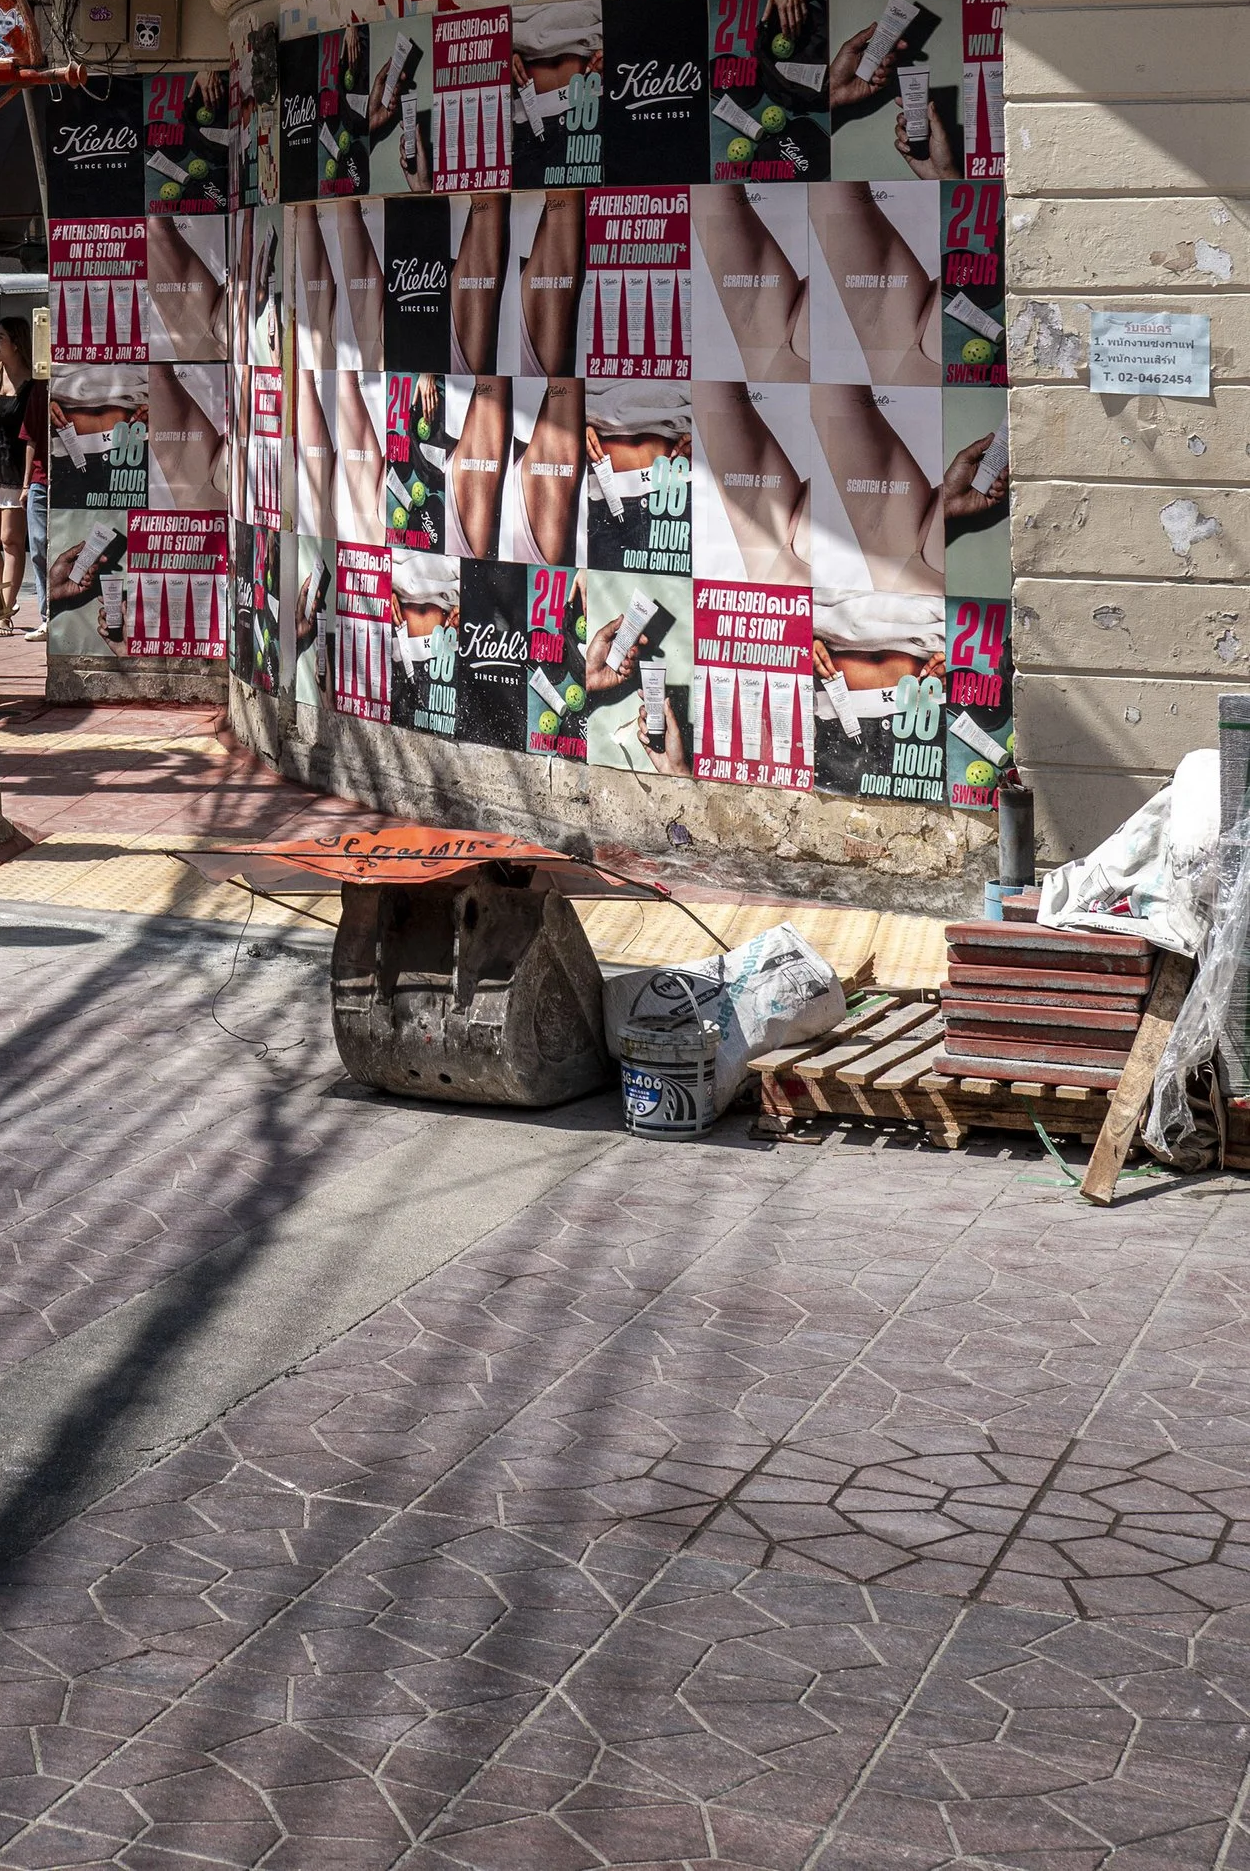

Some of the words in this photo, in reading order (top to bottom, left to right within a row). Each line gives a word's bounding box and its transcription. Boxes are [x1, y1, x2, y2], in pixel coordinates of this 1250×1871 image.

[968, 33, 995, 56] WIN
[320, 32, 340, 88] 24
[713, 57, 758, 88] HOUR
[610, 60, 702, 101] Kiehl's
[148, 76, 186, 121] 24
[566, 72, 601, 131] 96
[282, 94, 316, 130] Kiehl's
[632, 112, 662, 121] SINCE
[667, 110, 690, 119] 1851
[53, 125, 138, 154] Kiehl's
[147, 123, 185, 147] HOUR
[566, 134, 601, 164] HOUR
[779, 137, 809, 172] Kiehl's
[544, 166, 565, 184] ODOR
[566, 165, 602, 184] CONTROL
[715, 161, 748, 180] SWEAT
[750, 160, 796, 179] CONTROL
[947, 183, 1001, 248] 24
[606, 220, 619, 239] ON
[621, 220, 631, 239] IG
[634, 219, 668, 239] STORY
[70, 243, 83, 259] ON
[85, 243, 94, 258] IG
[96, 242, 126, 258] STORY
[589, 244, 608, 264] WIN
[610, 244, 617, 264] A
[52, 261, 72, 277] WIN
[73, 261, 81, 277] A
[388, 257, 447, 293] Kiehl's
[845, 275, 879, 288] SCRATCH
[887, 275, 909, 288] SNIFF
[946, 253, 999, 285] HOUR
[530, 276, 552, 289] SCRATCH
[559, 276, 573, 288] SNIFF
[1124, 321, 1172, 333] รับสมัคร
[54, 348, 65, 360] 22
[67, 348, 82, 360] JAN
[85, 347, 97, 359] '26
[104, 347, 113, 359] 31
[116, 346, 132, 359] JAN
[133, 345, 146, 359] '26
[1094, 337, 1104, 346] 1.
[1108, 338, 1194, 349] พนักงานชงกาแฟ
[590, 360, 599, 375] 22
[601, 360, 618, 375] JAN
[621, 359, 633, 376] '26
[641, 360, 651, 376] 31
[654, 359, 671, 376] JAN
[674, 359, 688, 377] '26
[1094, 354, 1104, 362] 2.
[1108, 354, 1176, 365] พนักงานเสิร์ฟ
[1104, 372, 1114, 382] T.
[1118, 372, 1192, 384] 02-0462454
[387, 376, 412, 431] 24
[109, 421, 147, 467] 96
[109, 469, 146, 492] HOUR
[649, 456, 689, 517] 96
[724, 473, 753, 488] SCRATCH
[762, 474, 781, 489] SNIFF
[846, 479, 880, 493] SCRATCH
[889, 481, 910, 494] SNIFF
[86, 493, 108, 507] ODOR
[110, 492, 147, 508] CONTROL
[649, 520, 690, 551] HOUR
[624, 549, 647, 569] ODOR
[650, 552, 691, 572] CONTROL
[530, 568, 568, 629] 24
[459, 622, 528, 660] Kiehl's
[717, 615, 733, 637] ON
[735, 616, 747, 638] IG
[748, 618, 786, 641] STORY
[951, 602, 1007, 669] 24
[530, 632, 565, 663] HOUR
[698, 639, 721, 660] WIN
[723, 642, 731, 662] A
[474, 672, 498, 684] SINCE
[501, 676, 519, 685] 1851
[951, 672, 1002, 707] HOUR
[892, 674, 943, 740] 96
[698, 758, 710, 777] 22
[712, 760, 731, 779] JAN
[734, 762, 749, 781] '26
[757, 765, 768, 783] 31
[772, 766, 791, 786] JAN
[795, 769, 810, 788] '26
[892, 743, 944, 777] HOUR
[861, 773, 890, 794] ODOR
[894, 776, 944, 800] CONTROL
[952, 784, 991, 804] SWEAT
